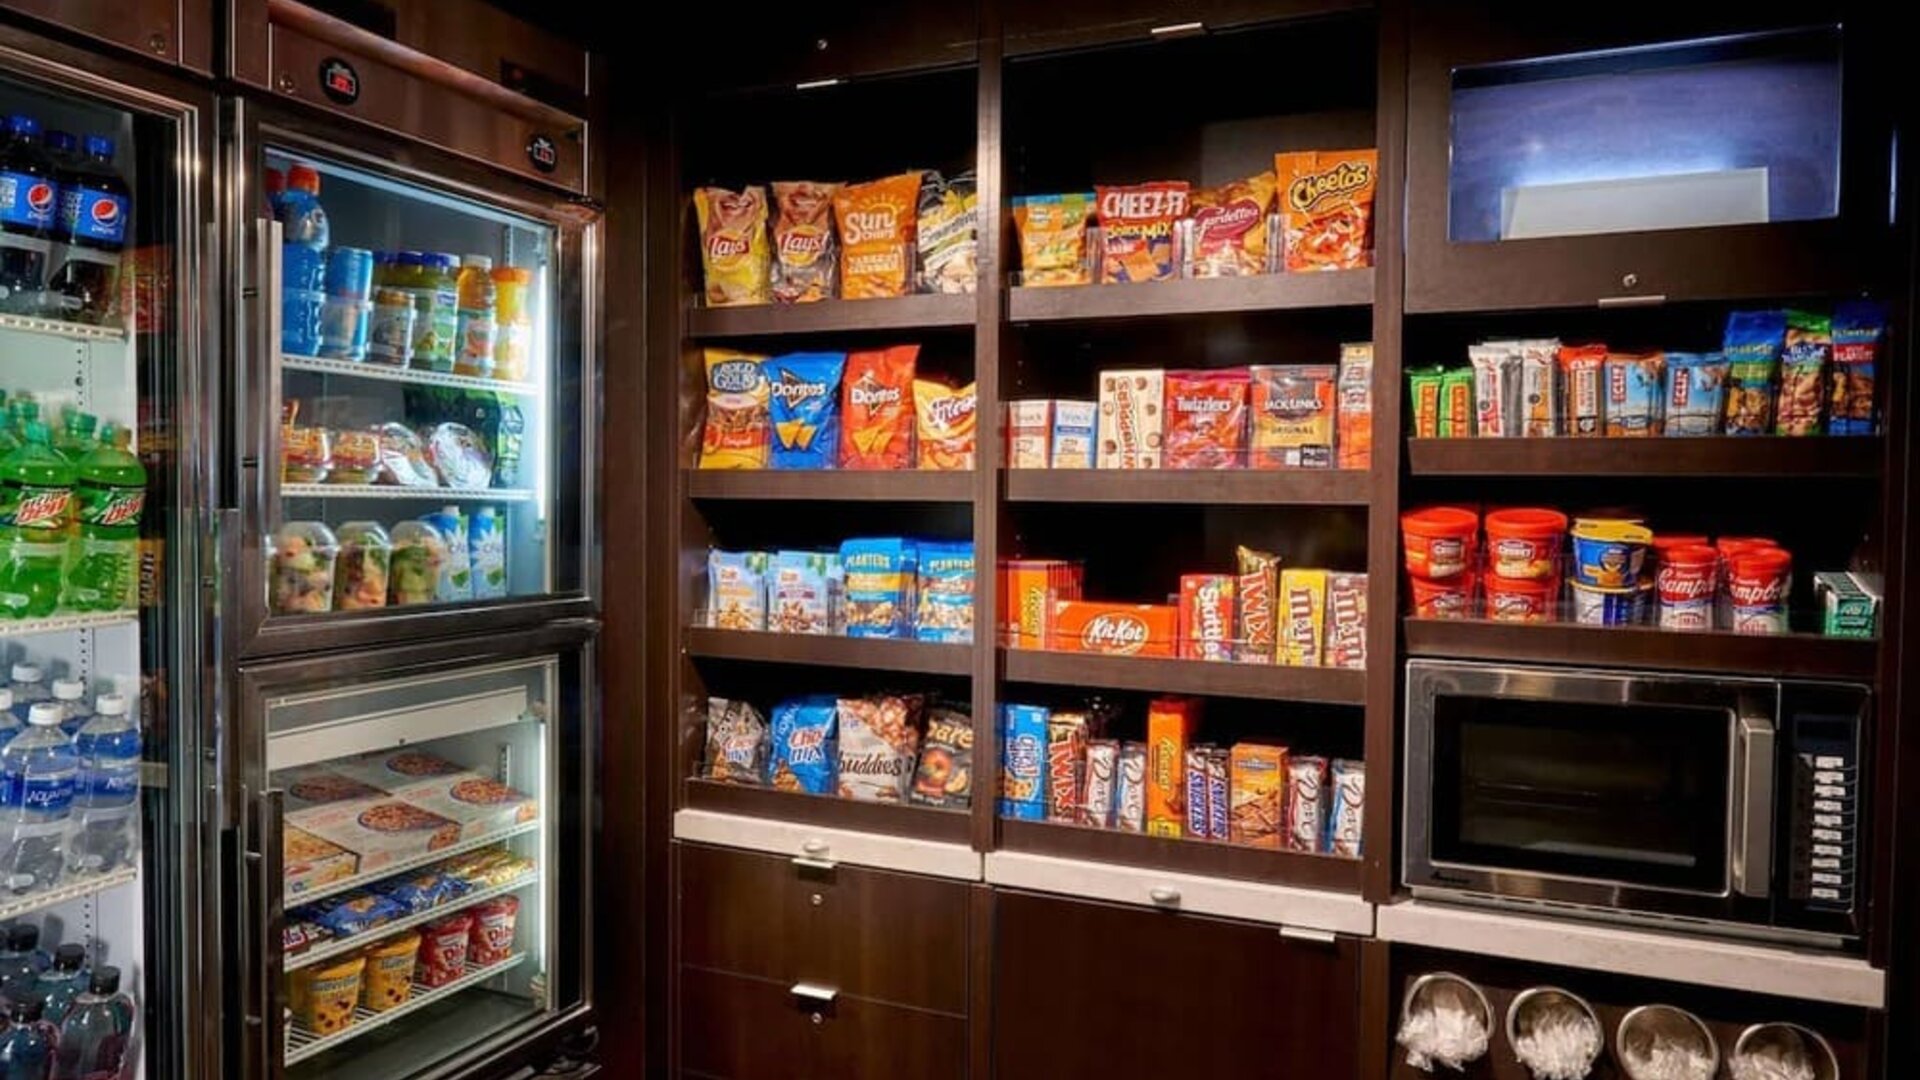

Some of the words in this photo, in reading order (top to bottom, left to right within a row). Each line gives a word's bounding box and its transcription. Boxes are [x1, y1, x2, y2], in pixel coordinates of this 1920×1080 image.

[1289, 162, 1369, 211] Cheetos
[771, 381, 826, 398] Doritos
[851, 386, 900, 404] Doritos
